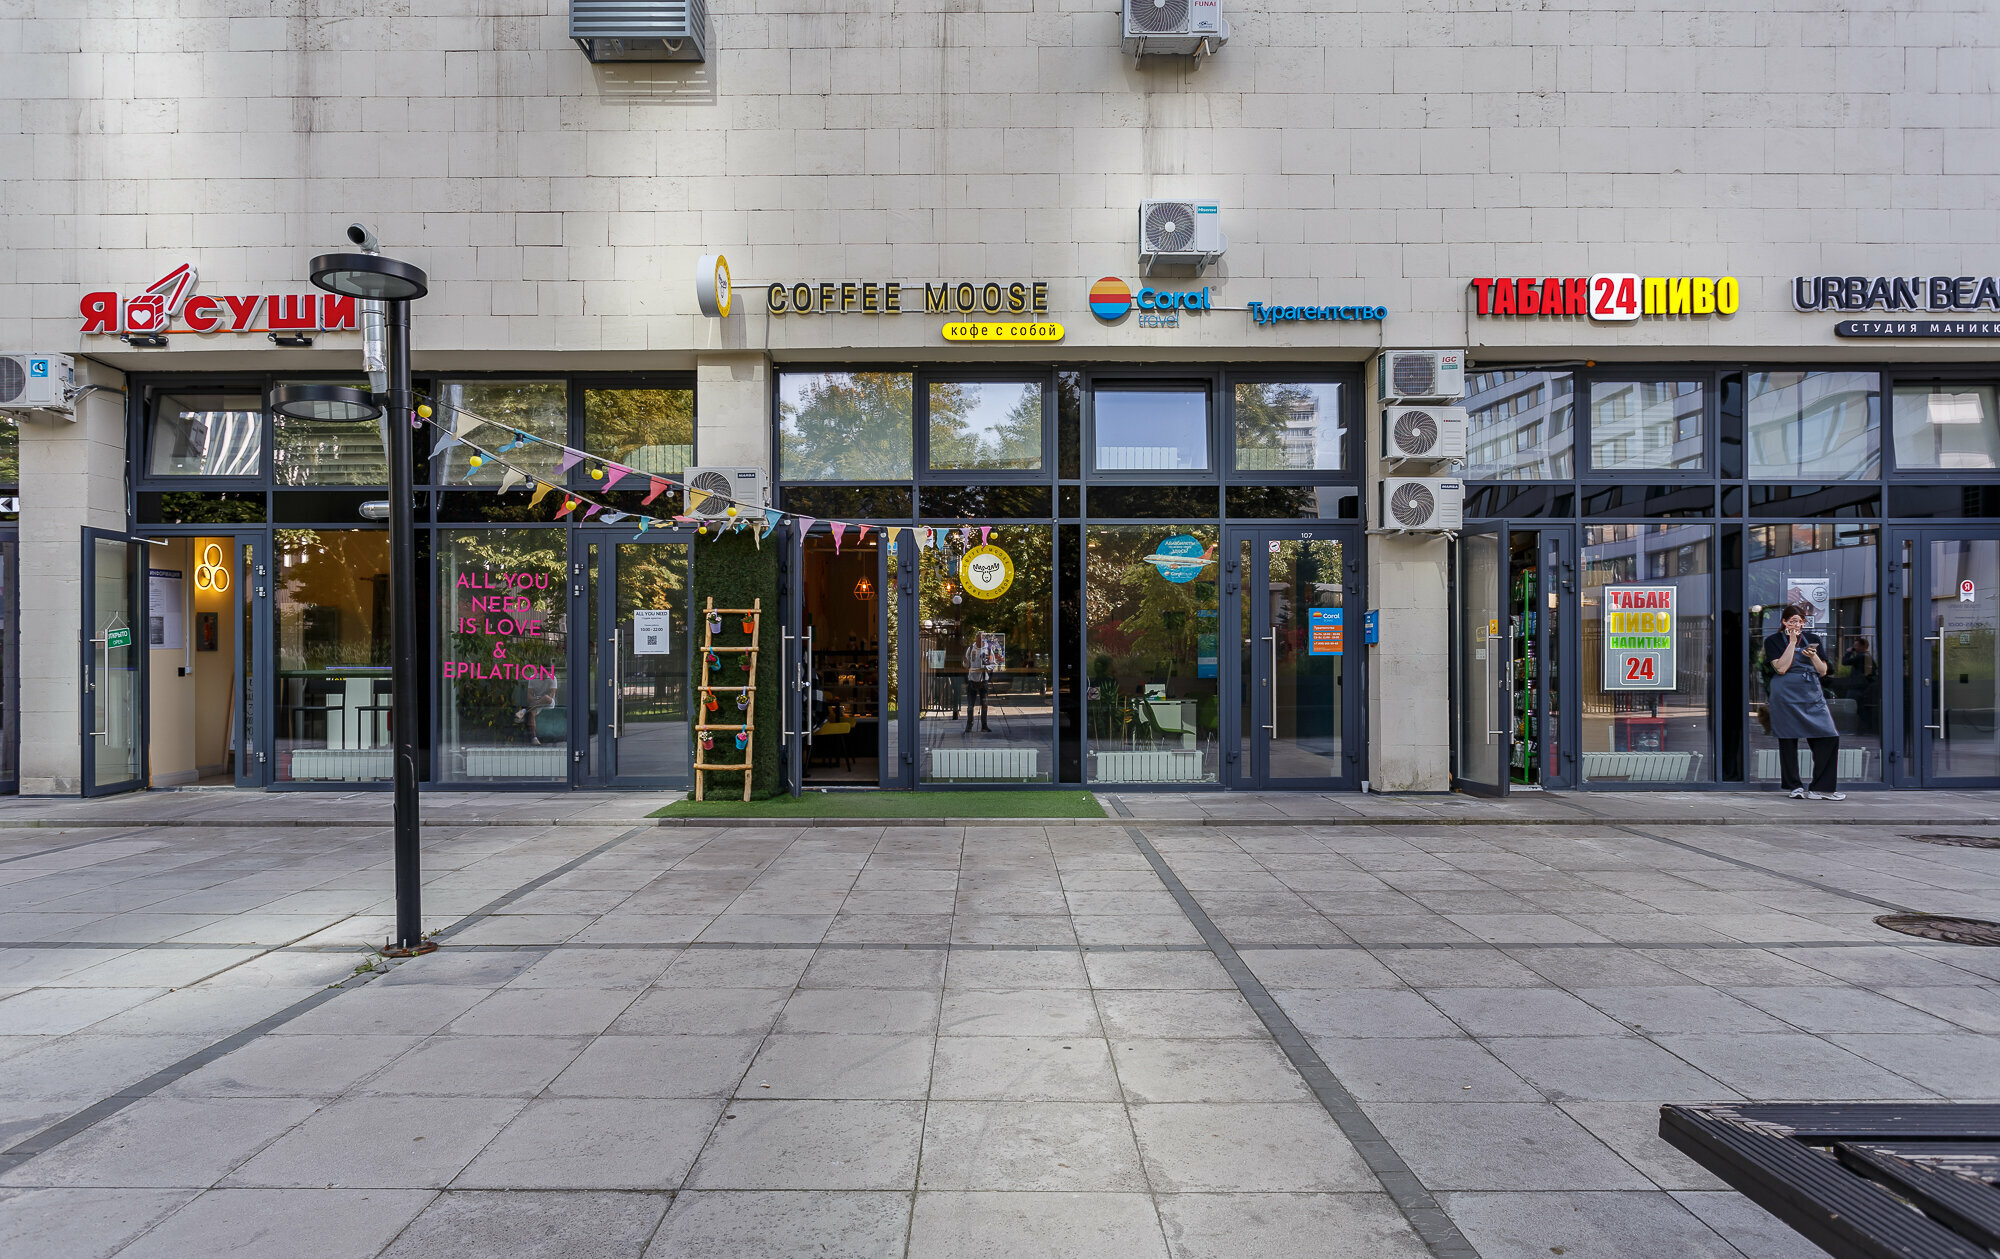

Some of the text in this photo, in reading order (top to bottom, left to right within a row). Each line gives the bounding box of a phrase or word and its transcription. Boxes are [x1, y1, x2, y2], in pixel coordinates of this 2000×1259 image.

[767, 282, 902, 314] COFFEE
[924, 282, 1049, 314] MOOSE
[1137, 286, 1210, 310] Coral
[1473, 276, 1739, 315] ТАБАК 24 ПИВО
[1793, 276, 2000, 312] URBAN BEA
[80, 291, 123, 333] Я
[1138, 311, 1180, 328] travel
[1248, 302, 1388, 325] Турагентство
[951, 324, 1056, 338] кофе с собой
[1851, 323, 1917, 333] СТУДИЯ
[456, 571, 549, 589] ALL YOU
[472, 596, 531, 612] NEED
[1610, 591, 1670, 609] ТАБАК
[460, 617, 542, 636] IS LOVE
[1610, 611, 1670, 633] ПИВО
[493, 641, 506, 659] &
[1610, 636, 1670, 649] НАПИТКИ
[444, 661, 555, 681] EPILATION
[1626, 657, 1654, 680] 24
